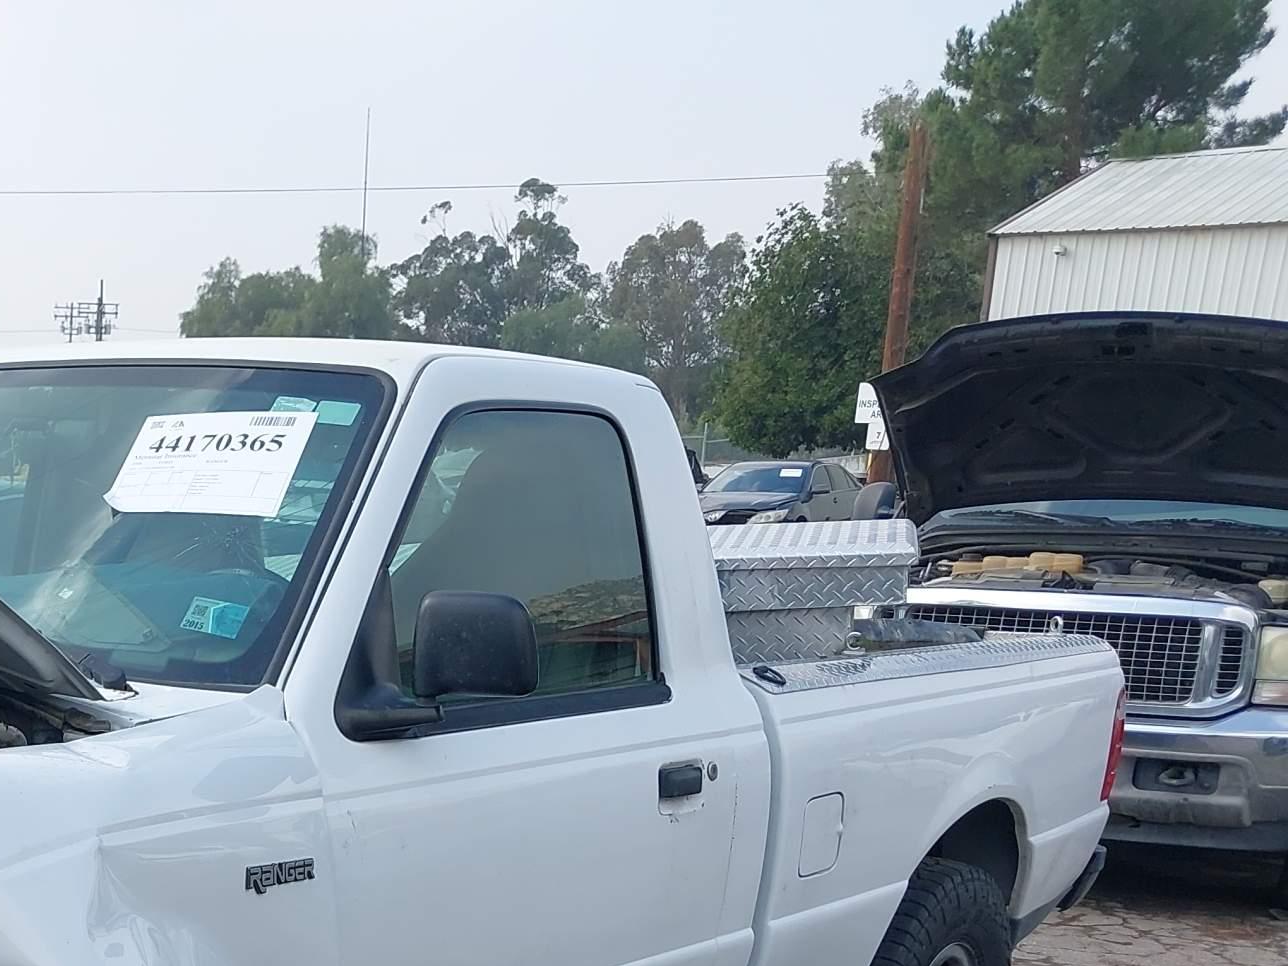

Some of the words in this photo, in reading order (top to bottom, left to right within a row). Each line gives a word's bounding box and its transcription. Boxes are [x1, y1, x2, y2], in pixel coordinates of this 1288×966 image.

[859, 400, 879, 408] INSP
[149, 433, 287, 453] 44170365
[182, 618, 205, 631] 2015
[245, 857, 315, 895] RANGER
